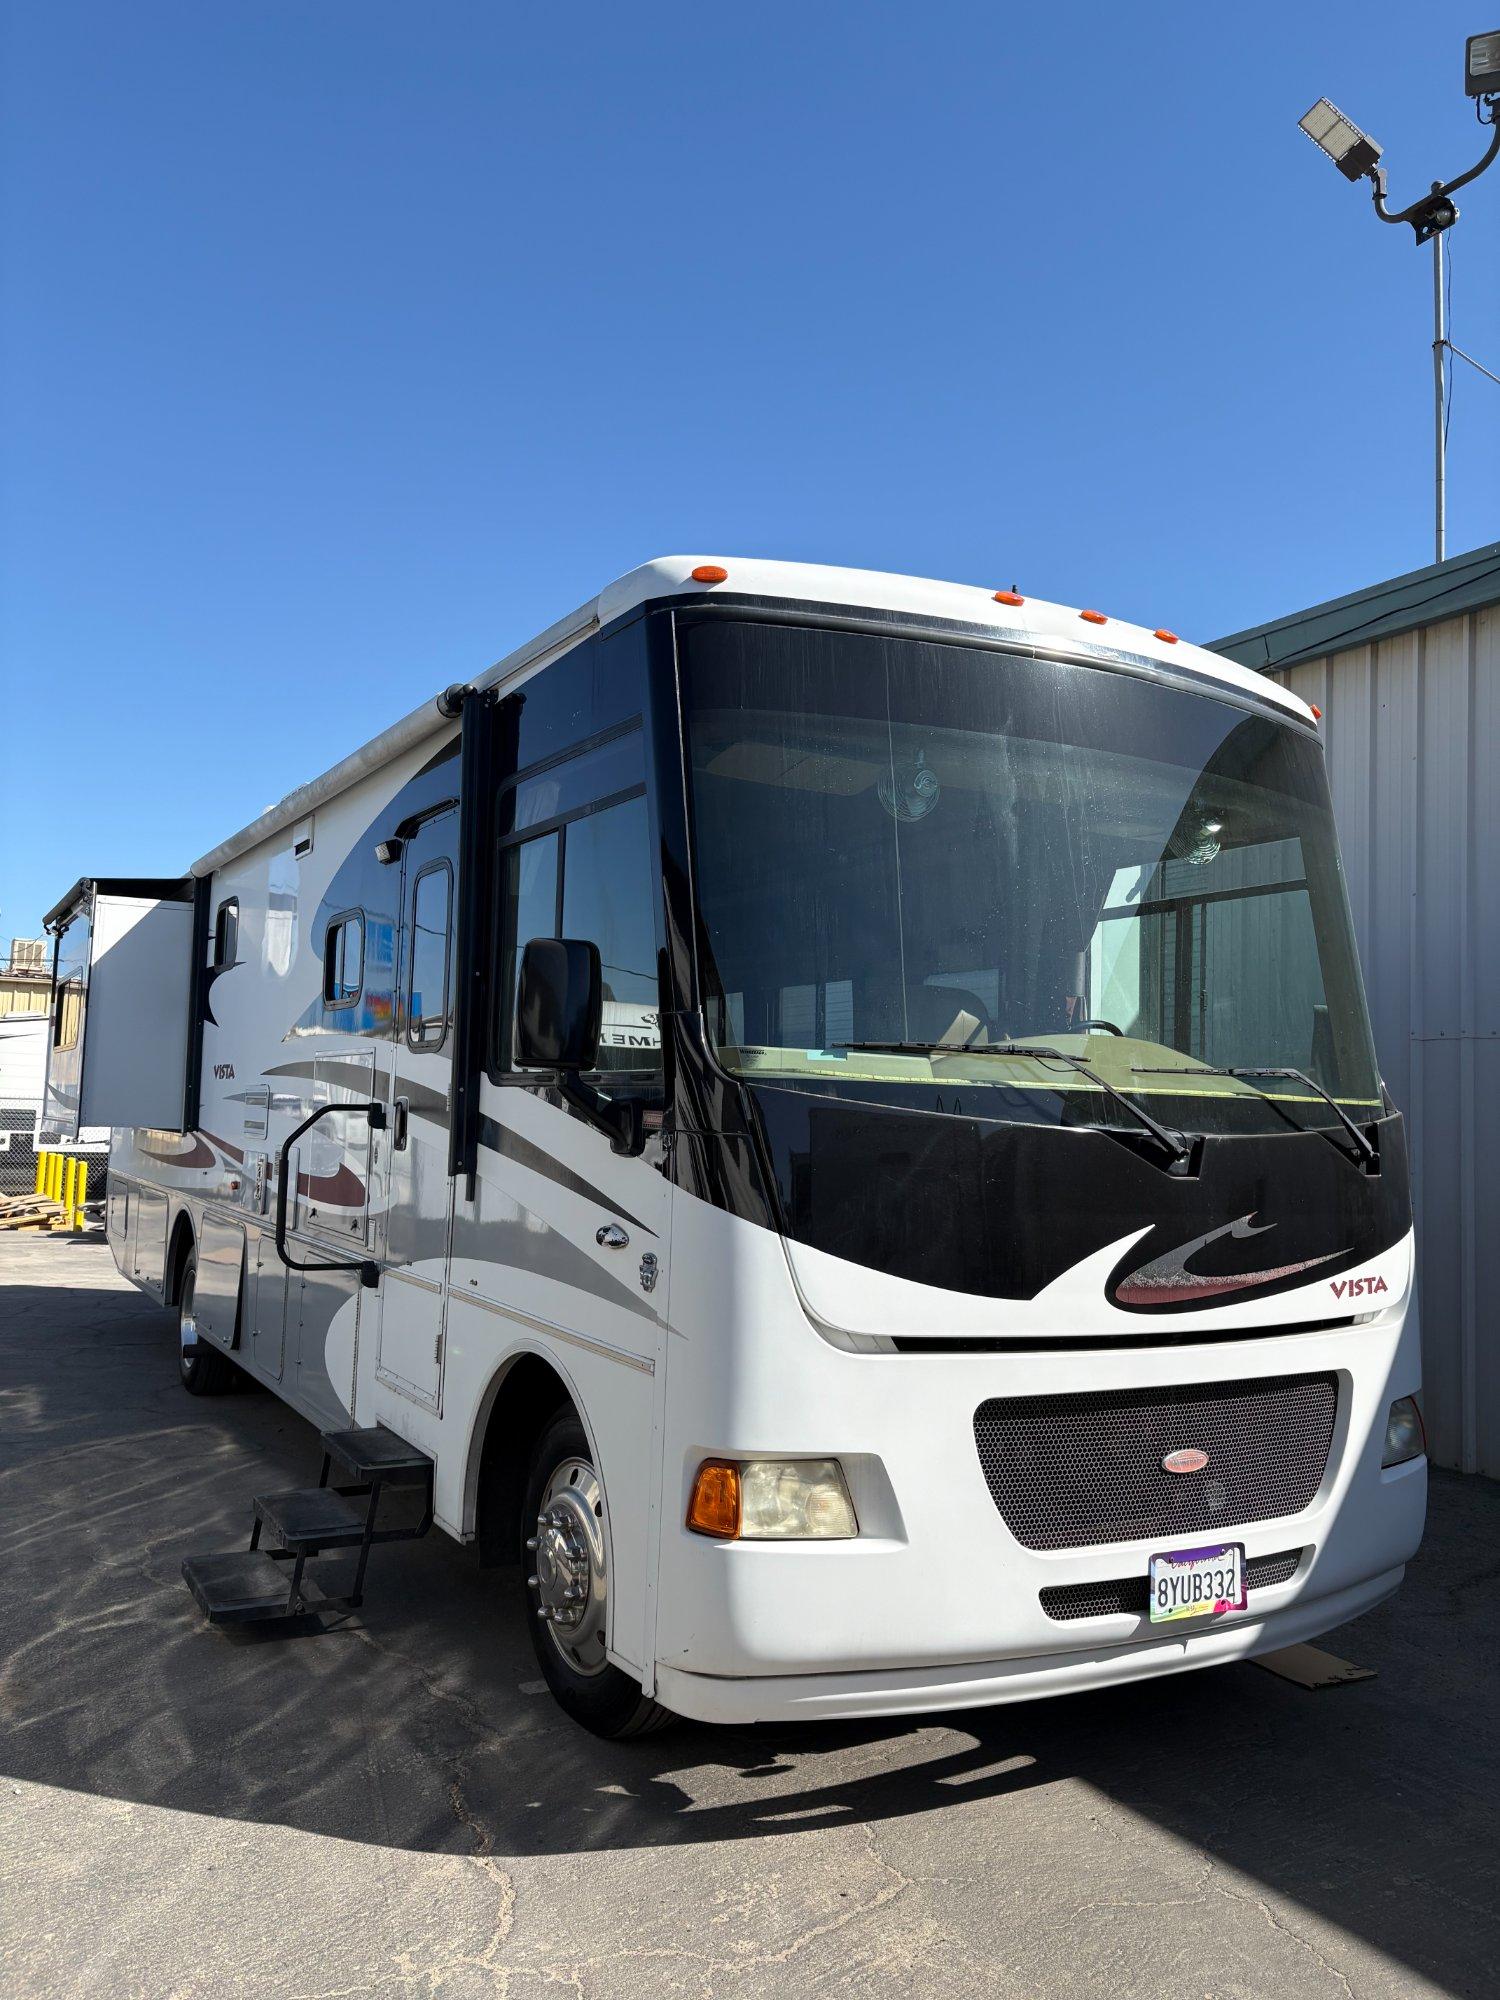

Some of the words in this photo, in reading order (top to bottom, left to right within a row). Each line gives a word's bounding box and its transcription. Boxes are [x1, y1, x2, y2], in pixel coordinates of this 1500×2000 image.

[214, 1064, 235, 1079] VISTA
[1330, 1275, 1388, 1299] VISTA
[1158, 1568, 1235, 1607] 8YUB332
